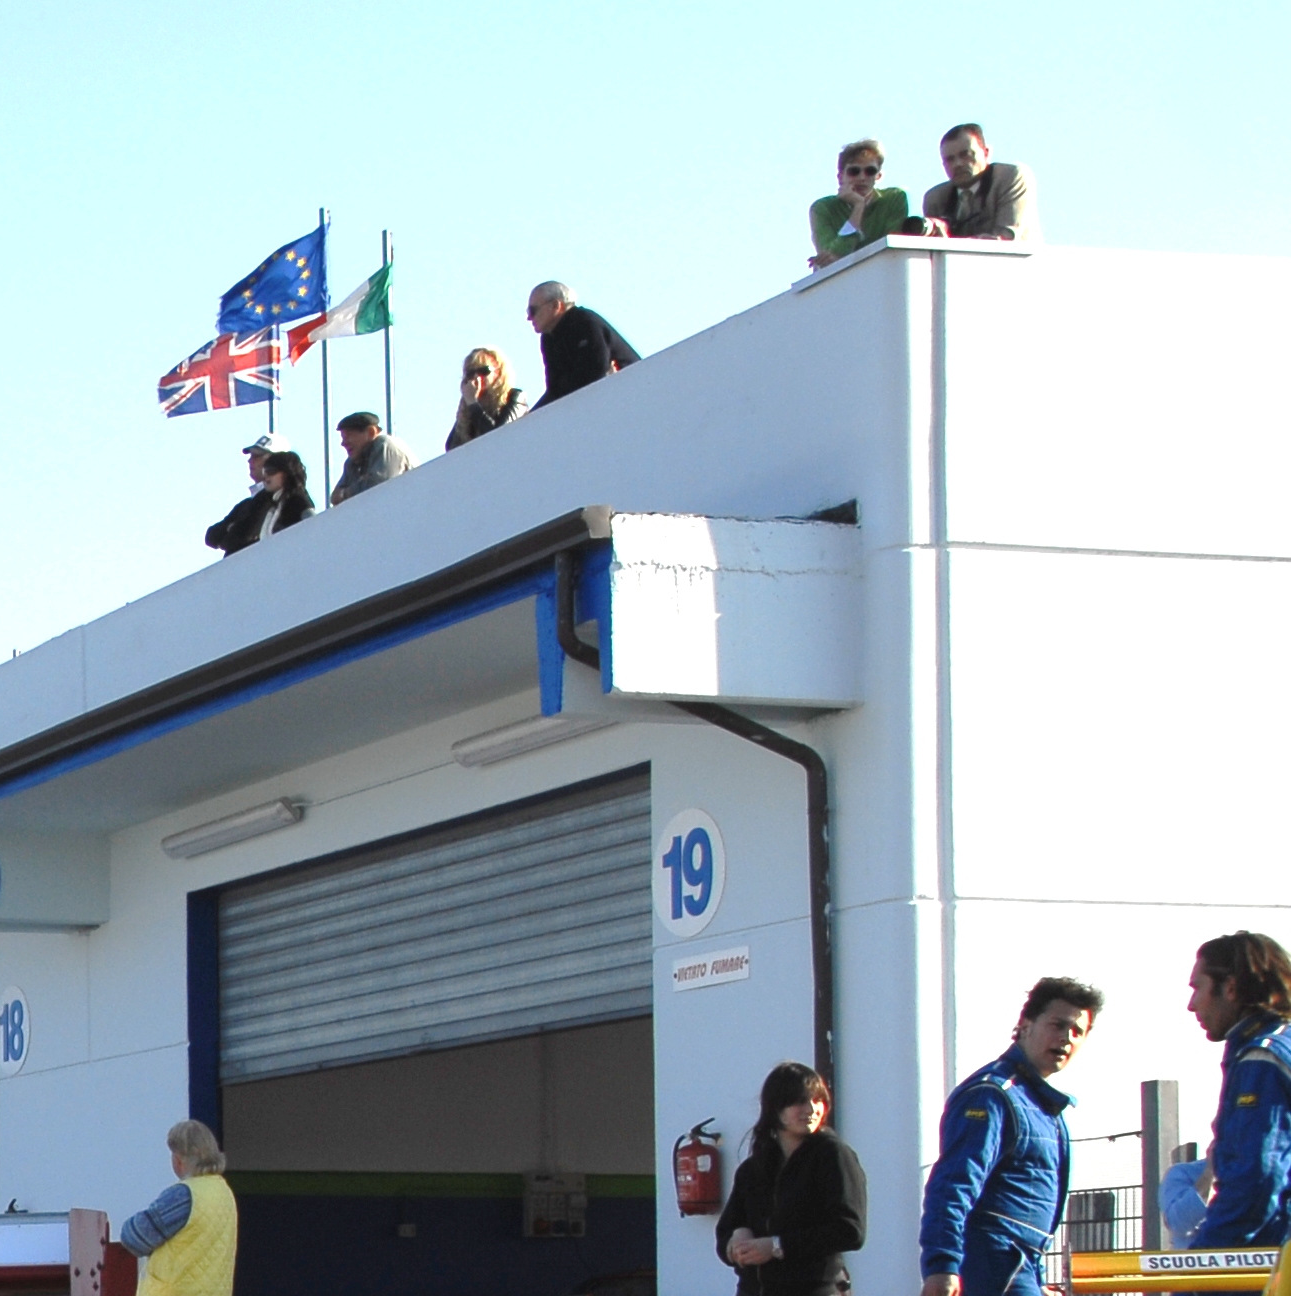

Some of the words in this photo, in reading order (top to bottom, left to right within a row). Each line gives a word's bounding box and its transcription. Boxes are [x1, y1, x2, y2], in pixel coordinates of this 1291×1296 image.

[662, 827, 713, 920] 19
[677, 962, 707, 983] VIETATO
[0, 1001, 24, 1062] 18
[1148, 1255, 1218, 1269] SCUOLA
